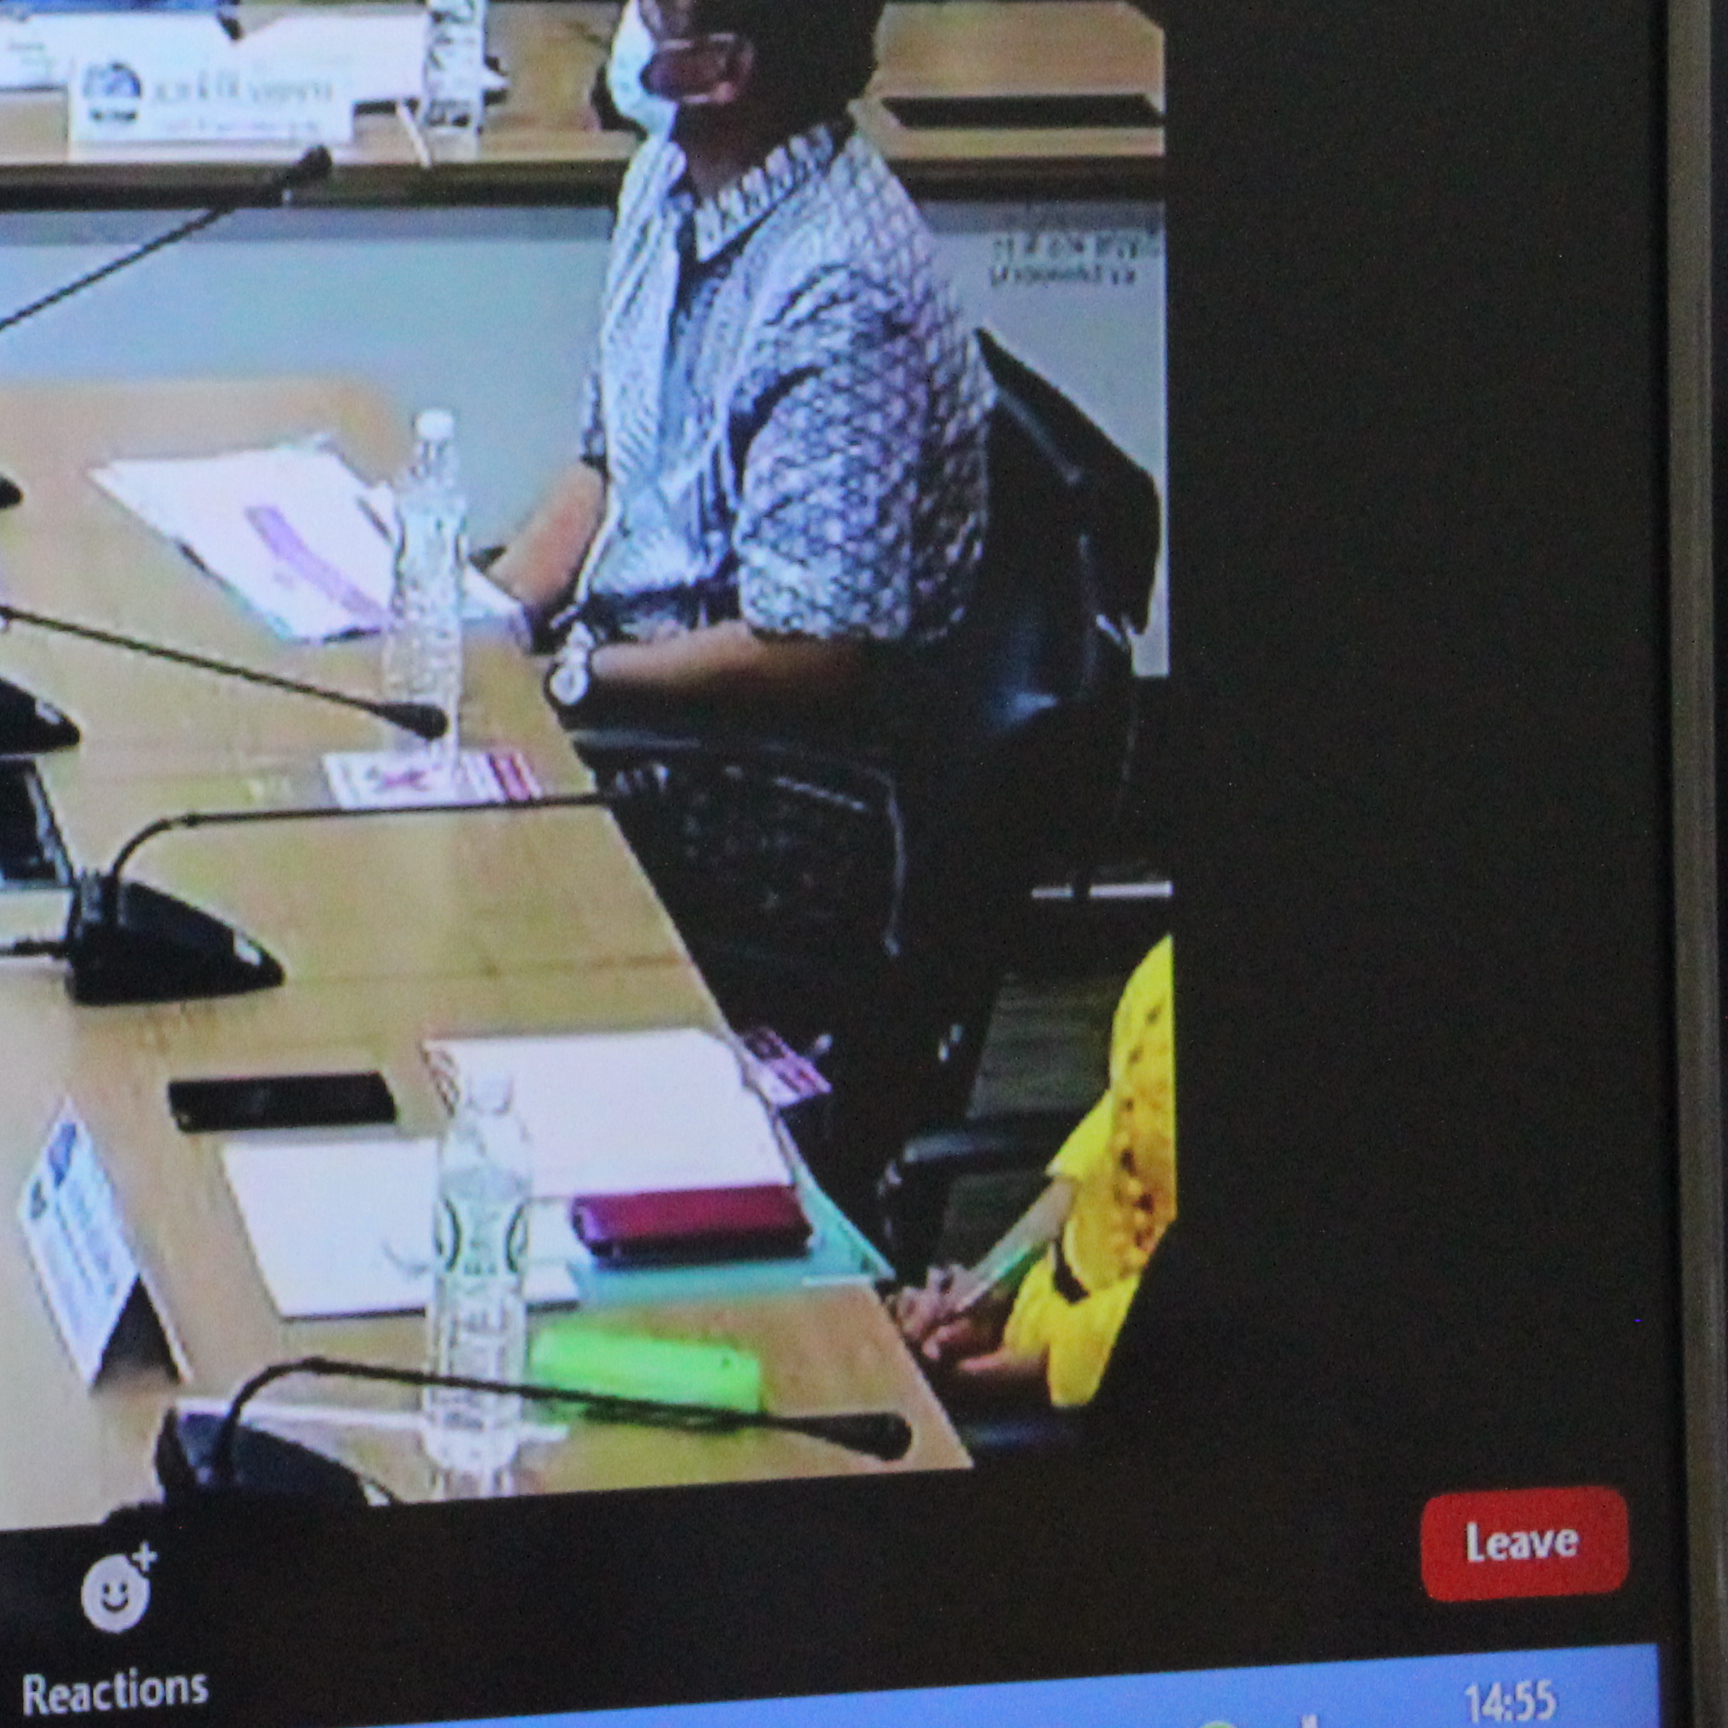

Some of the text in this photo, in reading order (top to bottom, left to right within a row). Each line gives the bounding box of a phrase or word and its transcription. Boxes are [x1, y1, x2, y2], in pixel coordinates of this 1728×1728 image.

[1465, 1518, 1581, 1565] Leave
[22, 1665, 209, 1717] Reactions
[1464, 1677, 1558, 1725] 14:55
